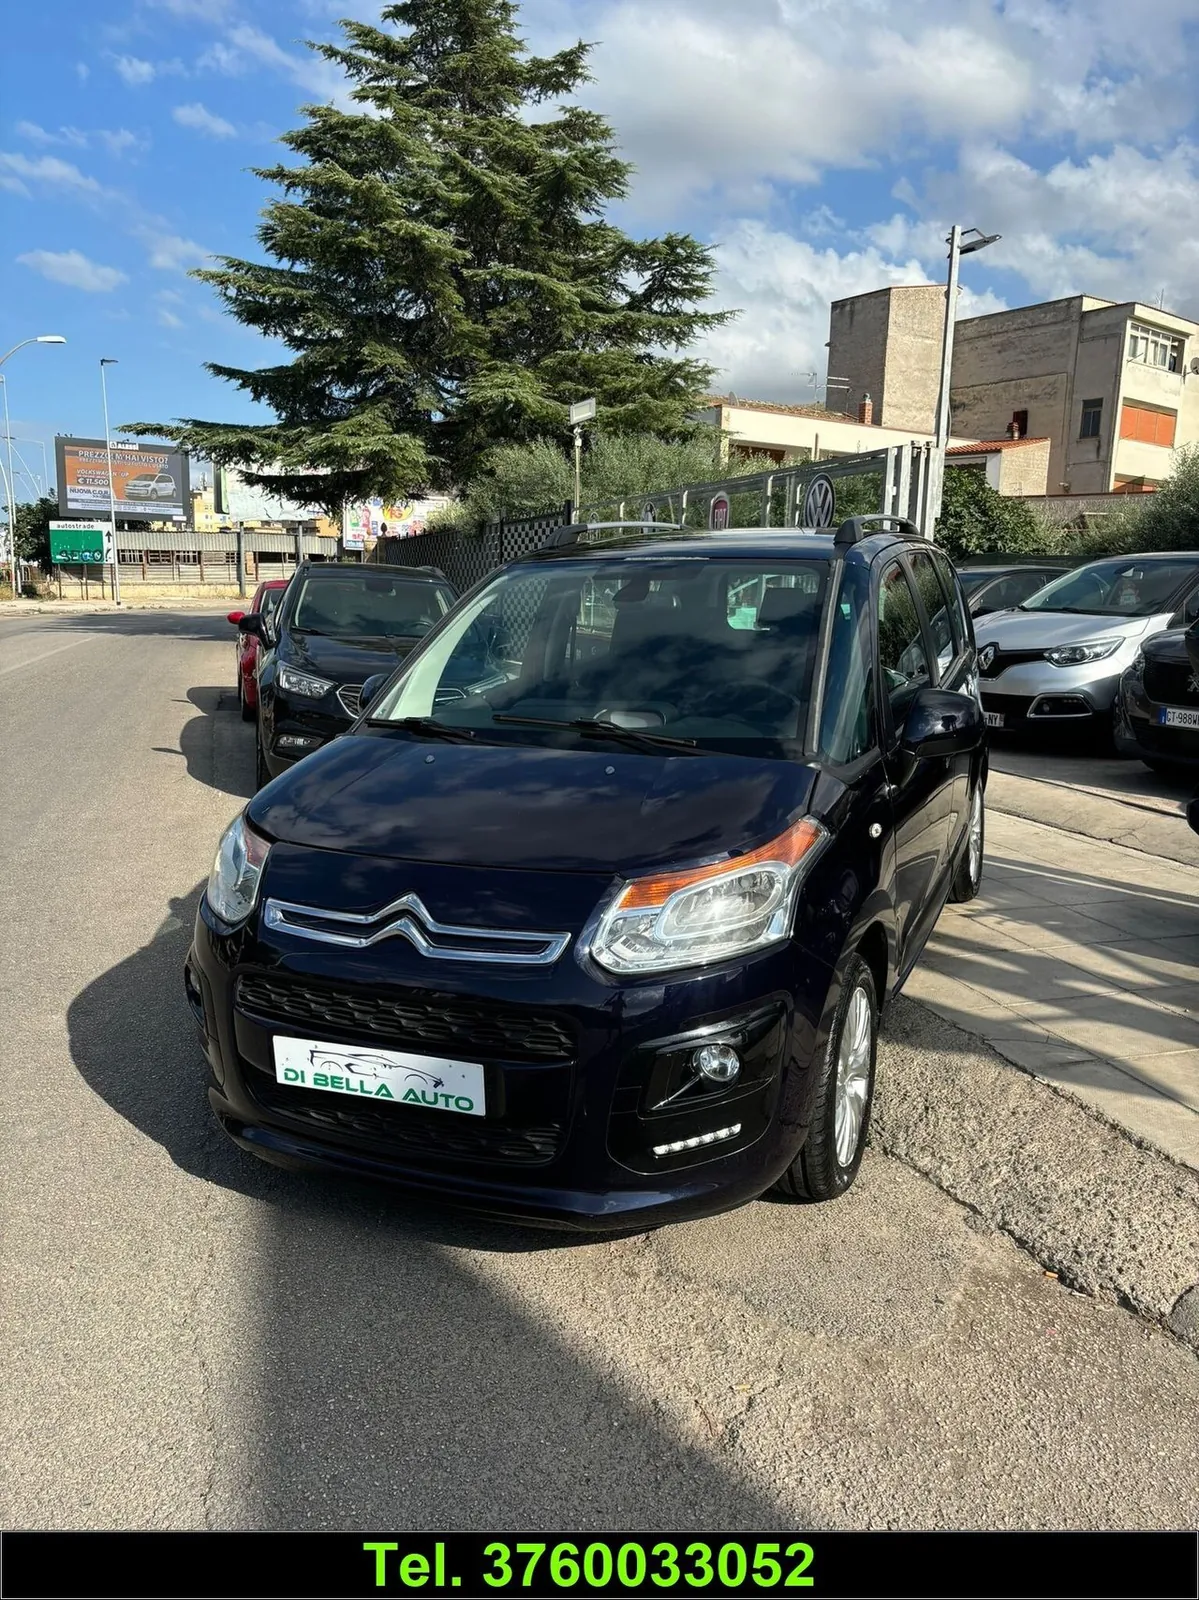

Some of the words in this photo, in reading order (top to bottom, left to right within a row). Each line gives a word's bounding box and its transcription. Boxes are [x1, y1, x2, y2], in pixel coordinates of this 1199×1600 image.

[141, 455, 168, 464] VISTO?
[86, 478, 109, 486] 11.500
[284, 1067, 306, 1084] DI
[313, 1072, 395, 1099] BELLA
[401, 1087, 474, 1112] AUTO
